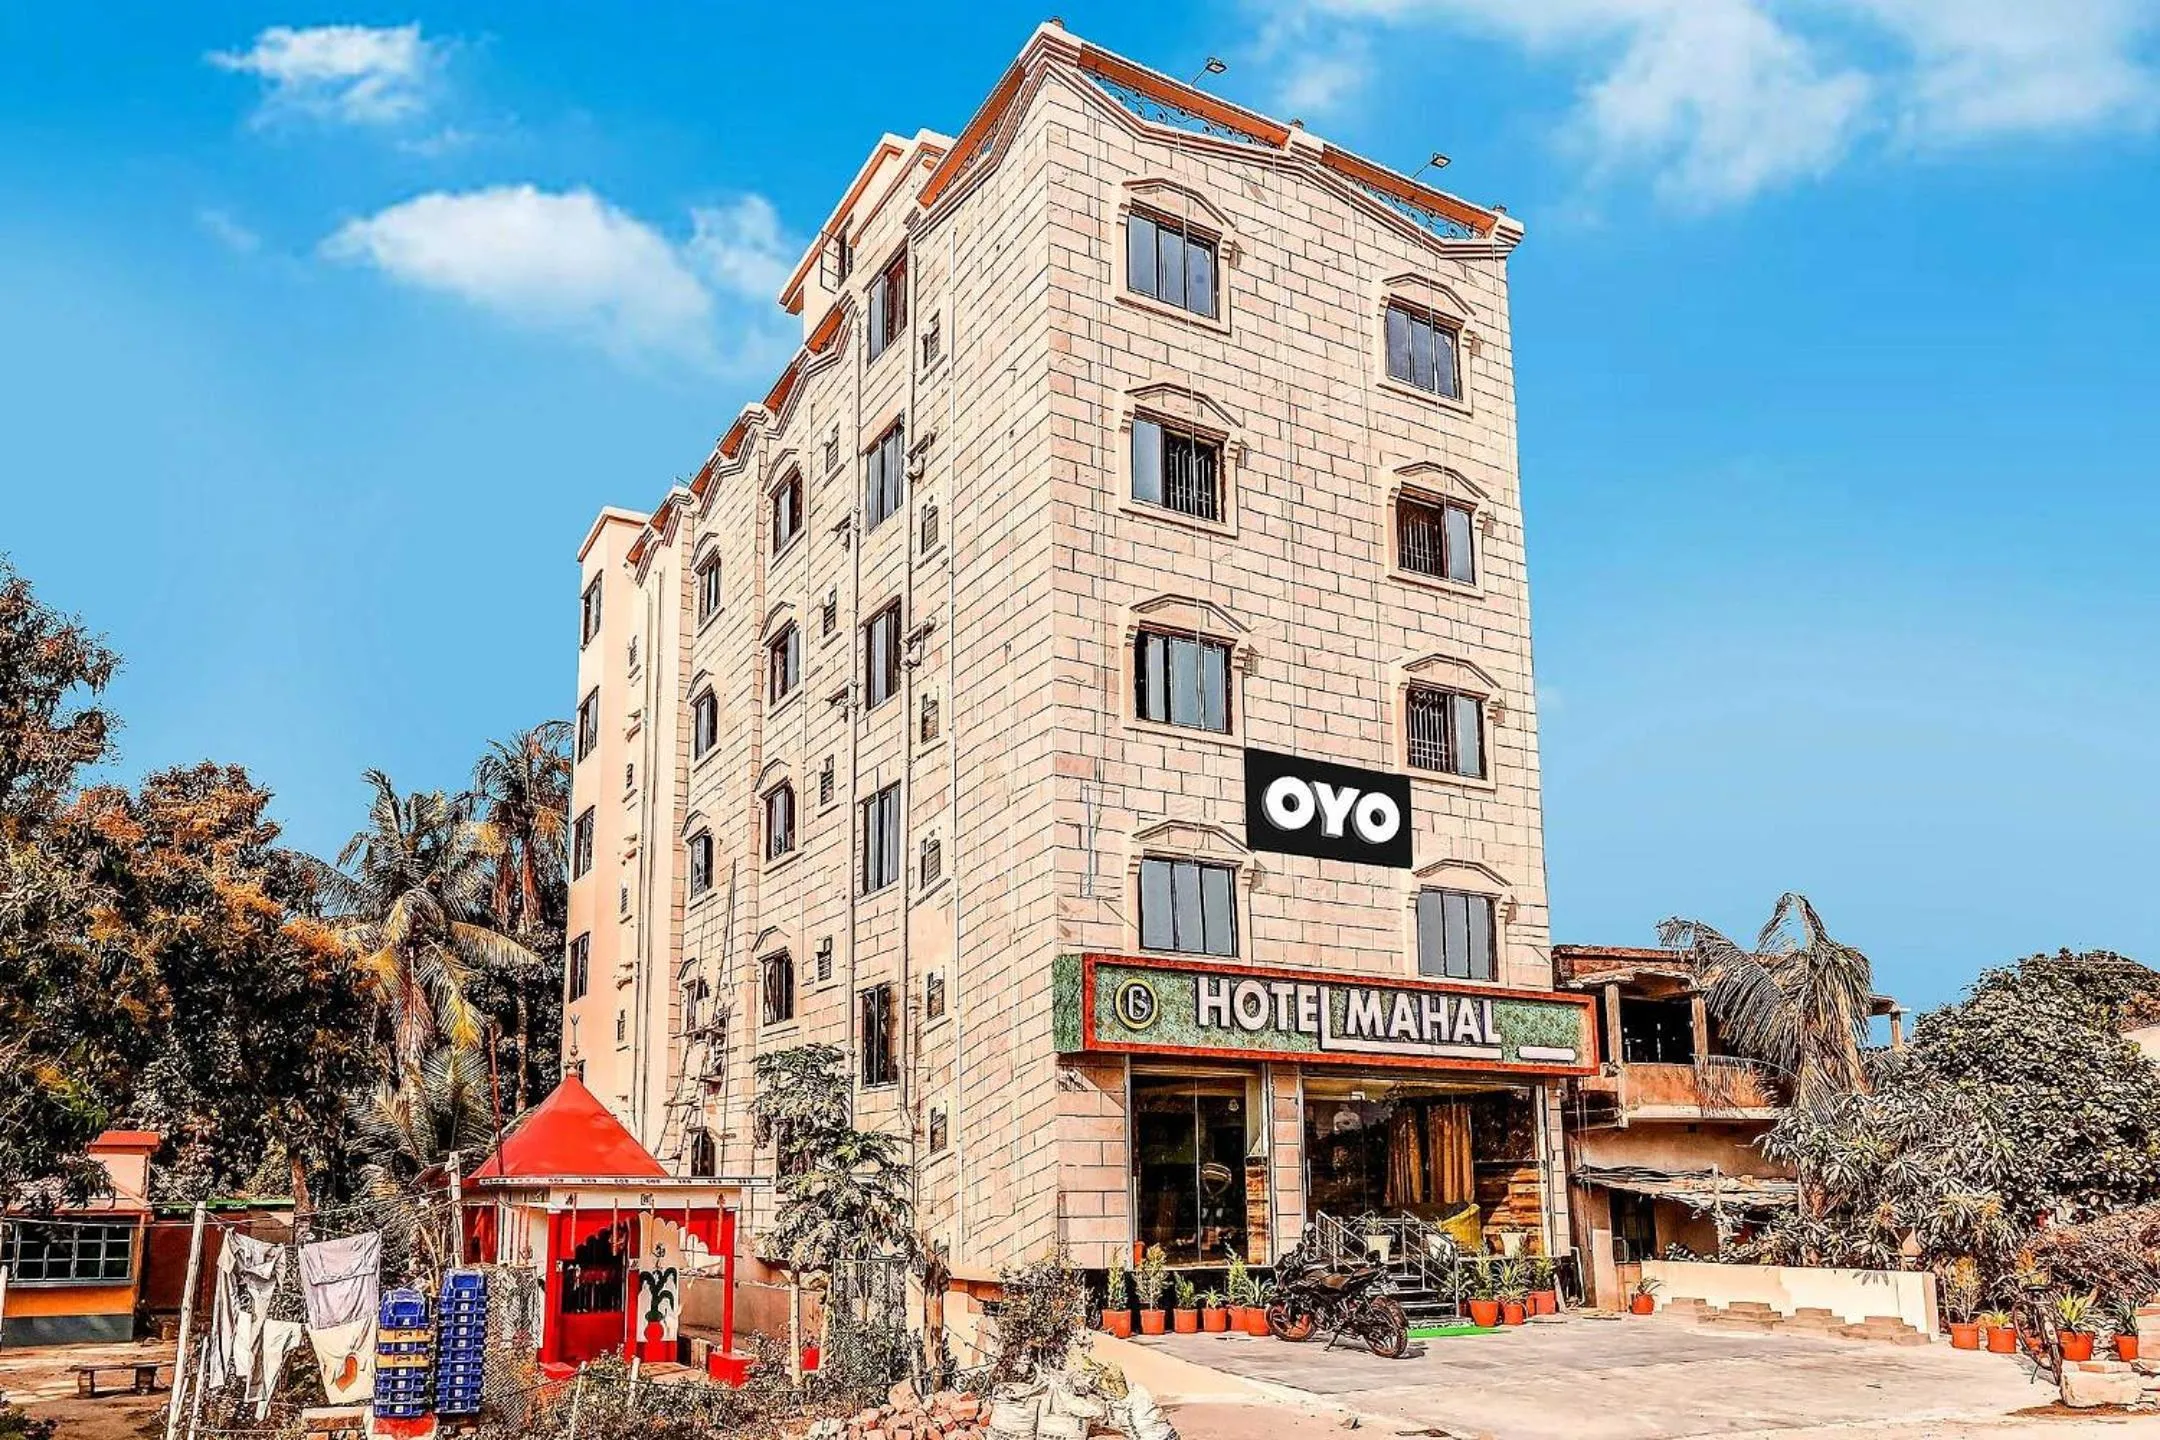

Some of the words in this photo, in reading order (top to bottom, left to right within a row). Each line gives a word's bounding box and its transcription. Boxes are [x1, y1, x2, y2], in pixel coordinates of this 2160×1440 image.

[1263, 775, 1401, 844] OYO
[1197, 977, 1332, 1049] HOTEL
[1346, 988, 1501, 1043] MAHAL
